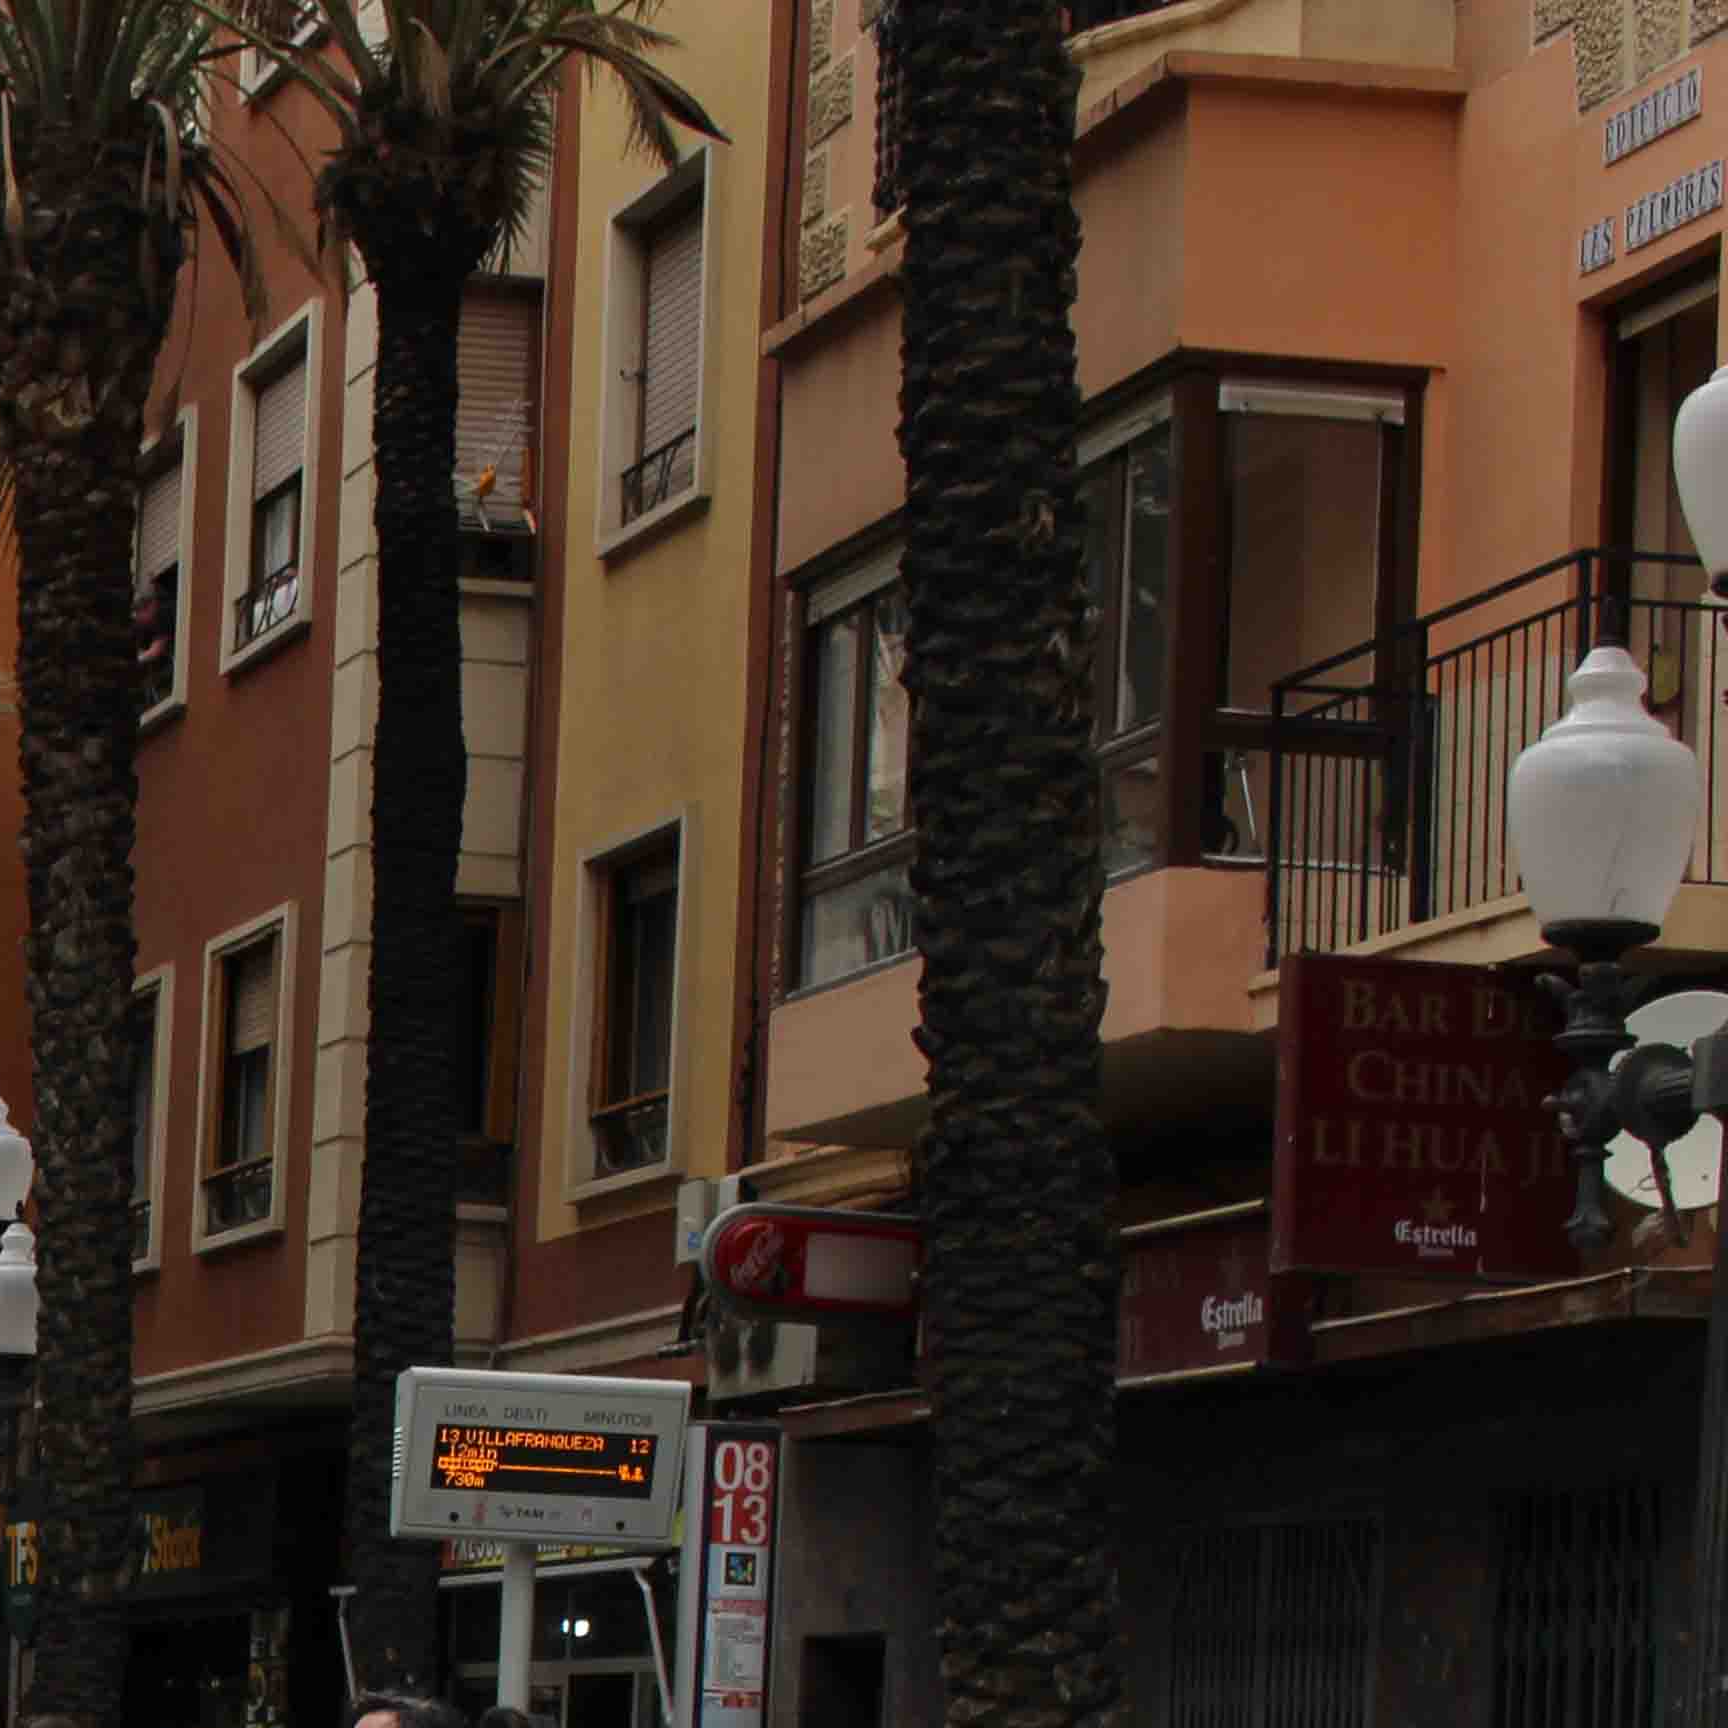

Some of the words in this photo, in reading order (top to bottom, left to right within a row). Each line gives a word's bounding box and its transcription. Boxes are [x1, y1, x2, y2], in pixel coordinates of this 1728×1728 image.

[1343, 1048, 1531, 1109] CHINA
[1393, 1219, 1479, 1248] Estrella
[439, 1429, 461, 1443] 13
[464, 1431, 604, 1452] VILLAFRANQUEZA
[630, 1439, 651, 1454] 12
[448, 1444, 498, 1460] 12min
[444, 1471, 485, 1489] 730m
[714, 1441, 769, 1493] 08
[712, 1492, 768, 1544] 13
